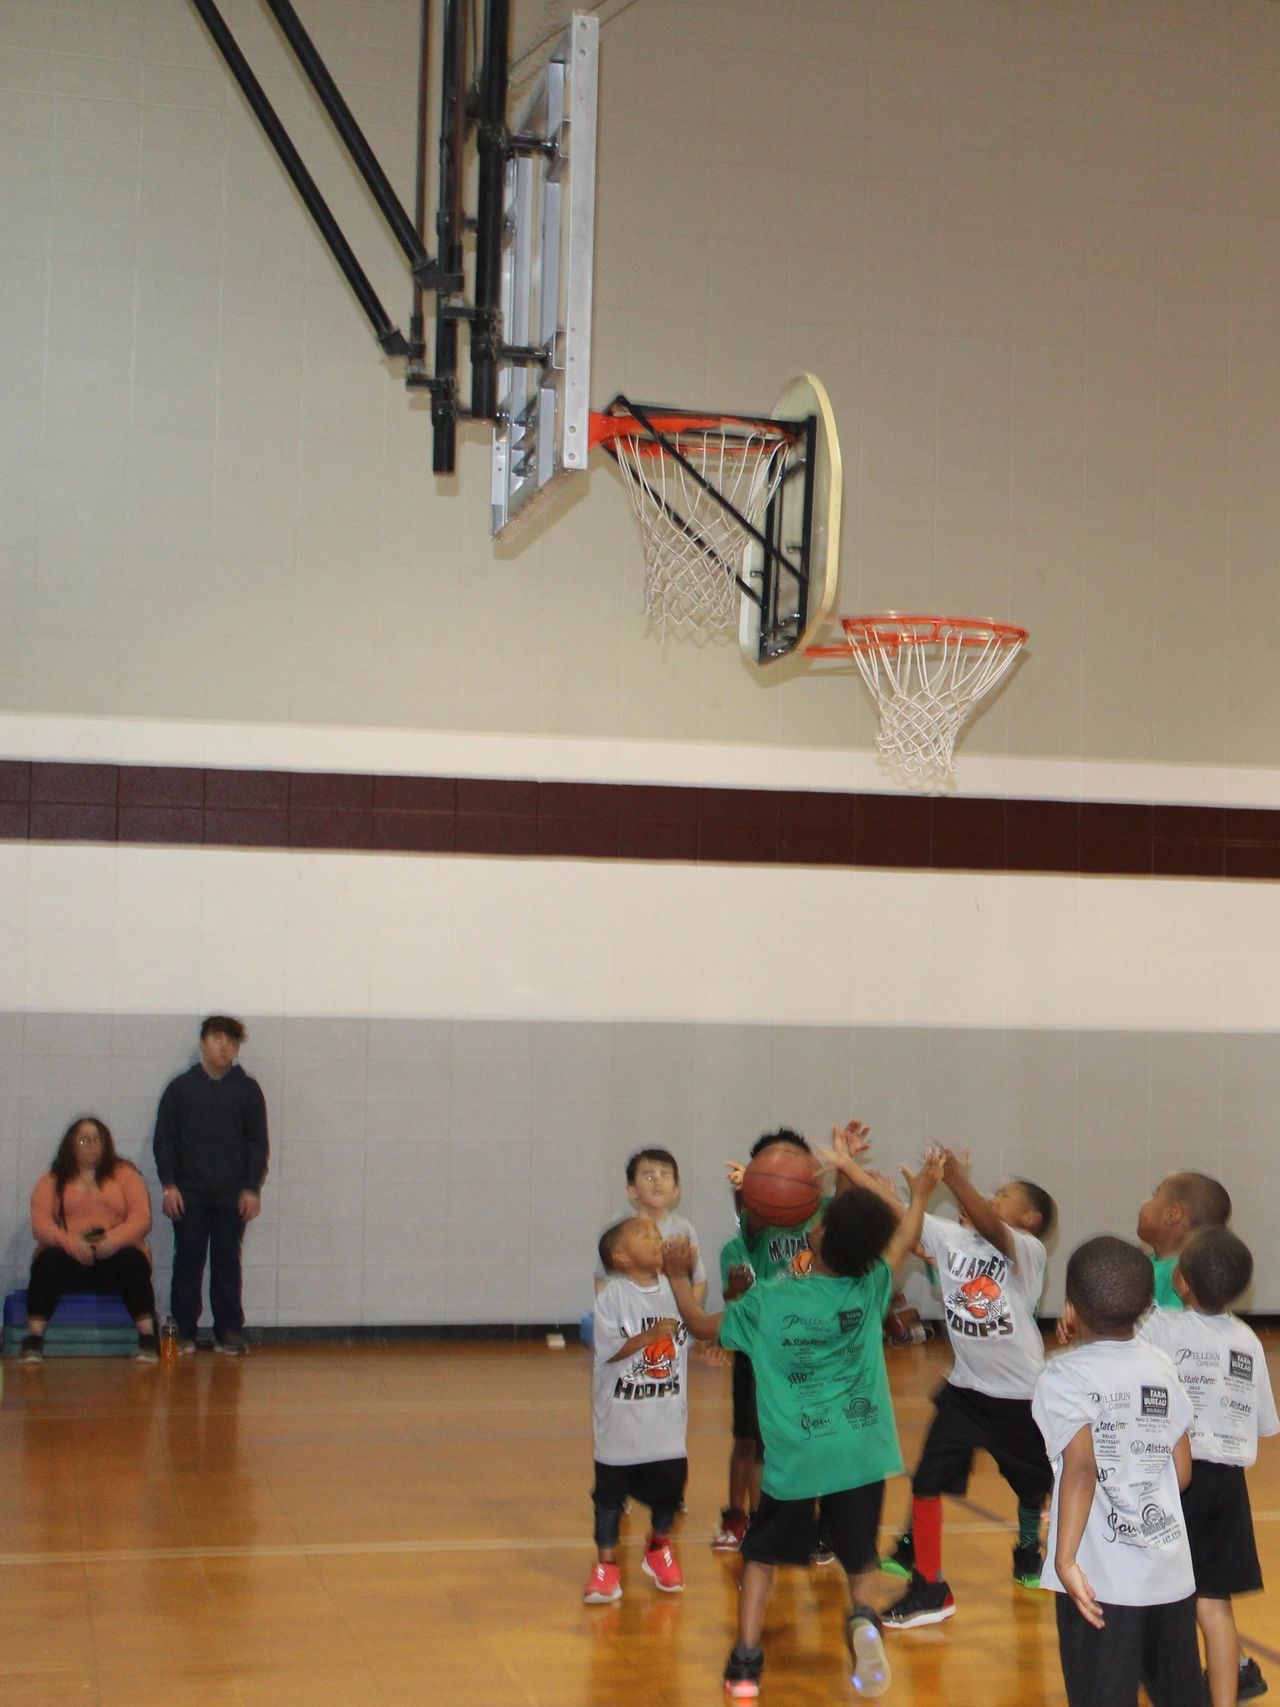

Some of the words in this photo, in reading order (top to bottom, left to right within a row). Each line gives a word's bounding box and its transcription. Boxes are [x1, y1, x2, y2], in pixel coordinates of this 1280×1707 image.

[613, 1375, 681, 1400] HOOPS
[1149, 1389, 1167, 1399] FARM
[1144, 1397, 1167, 1407] BUREAU
